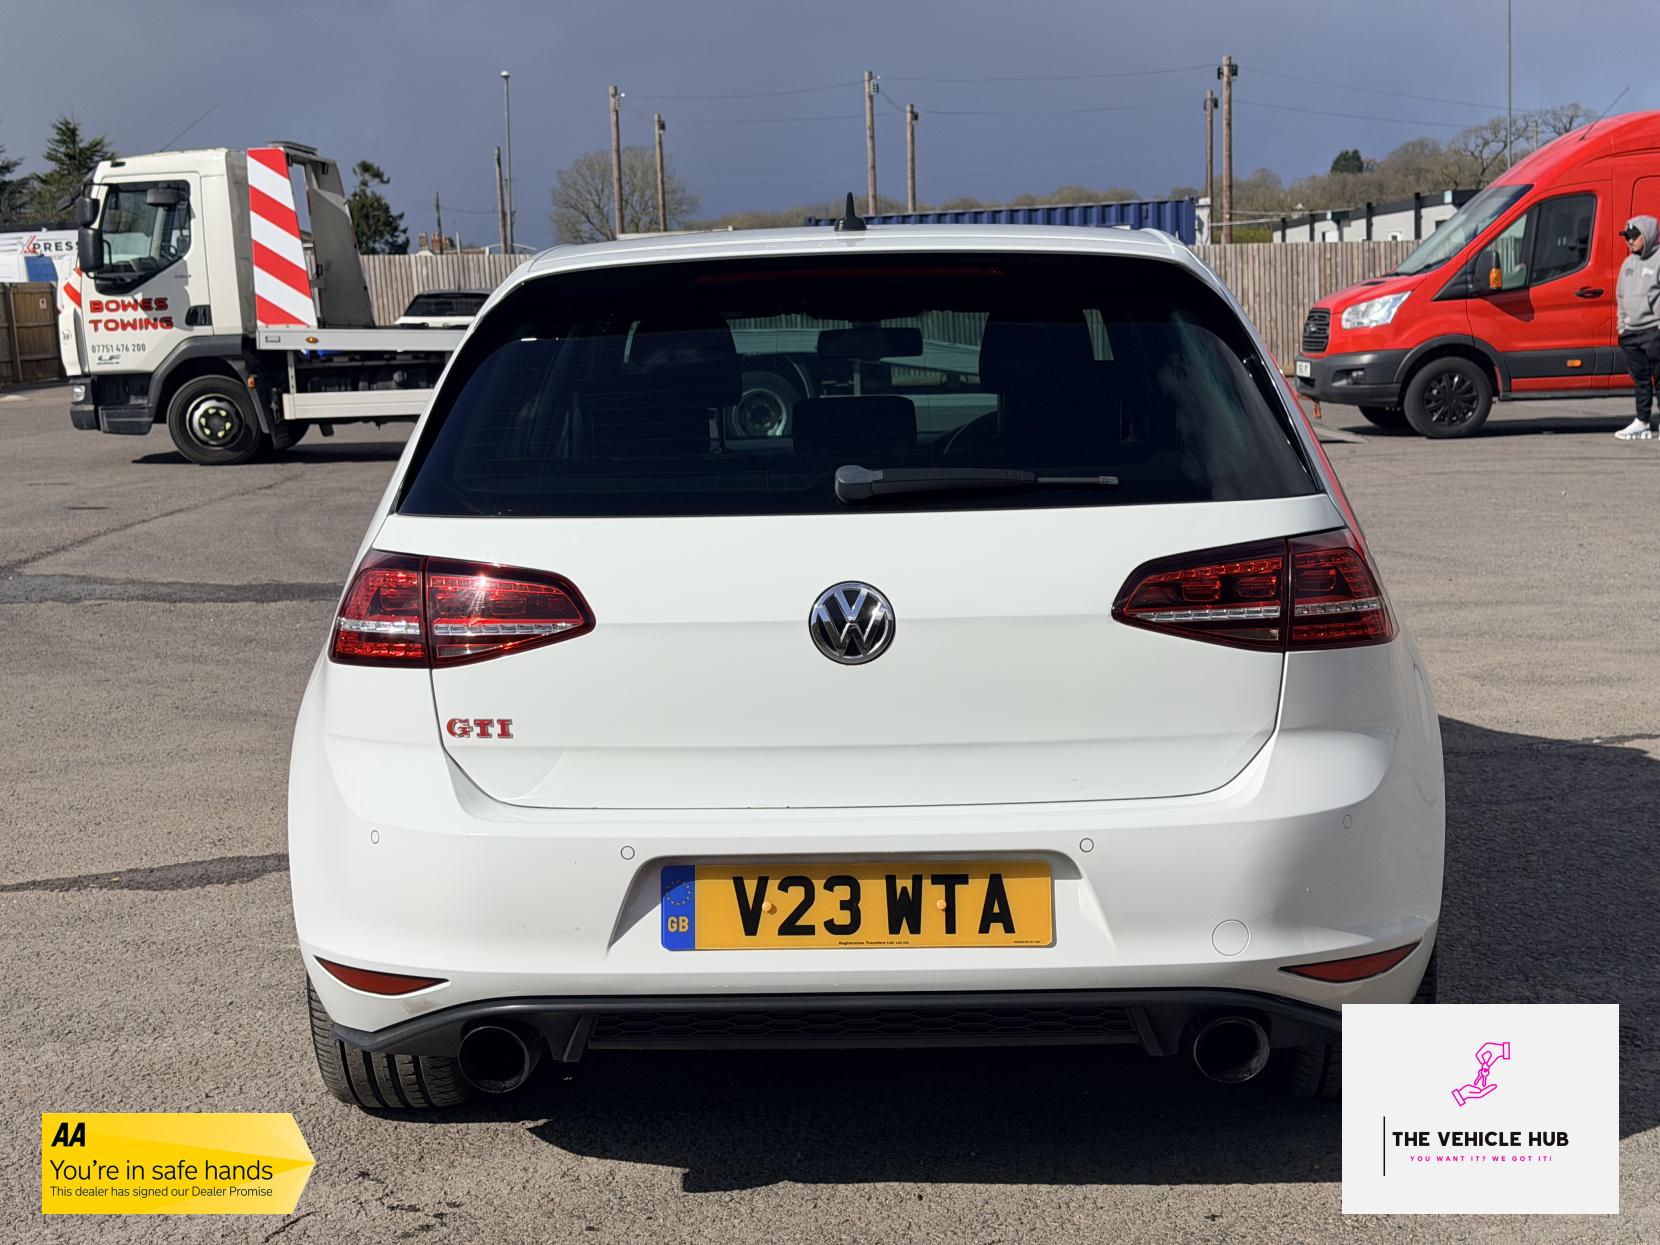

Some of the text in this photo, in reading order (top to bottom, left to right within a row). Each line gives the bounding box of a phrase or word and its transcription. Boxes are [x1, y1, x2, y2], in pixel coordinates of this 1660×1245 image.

[89, 297, 169, 313] BOWES
[88, 316, 175, 332] TOWING
[91, 343, 146, 353] 07751 476 200
[446, 718, 514, 740] GTI
[732, 873, 1016, 937] V23 WTA
[667, 916, 689, 933] GB
